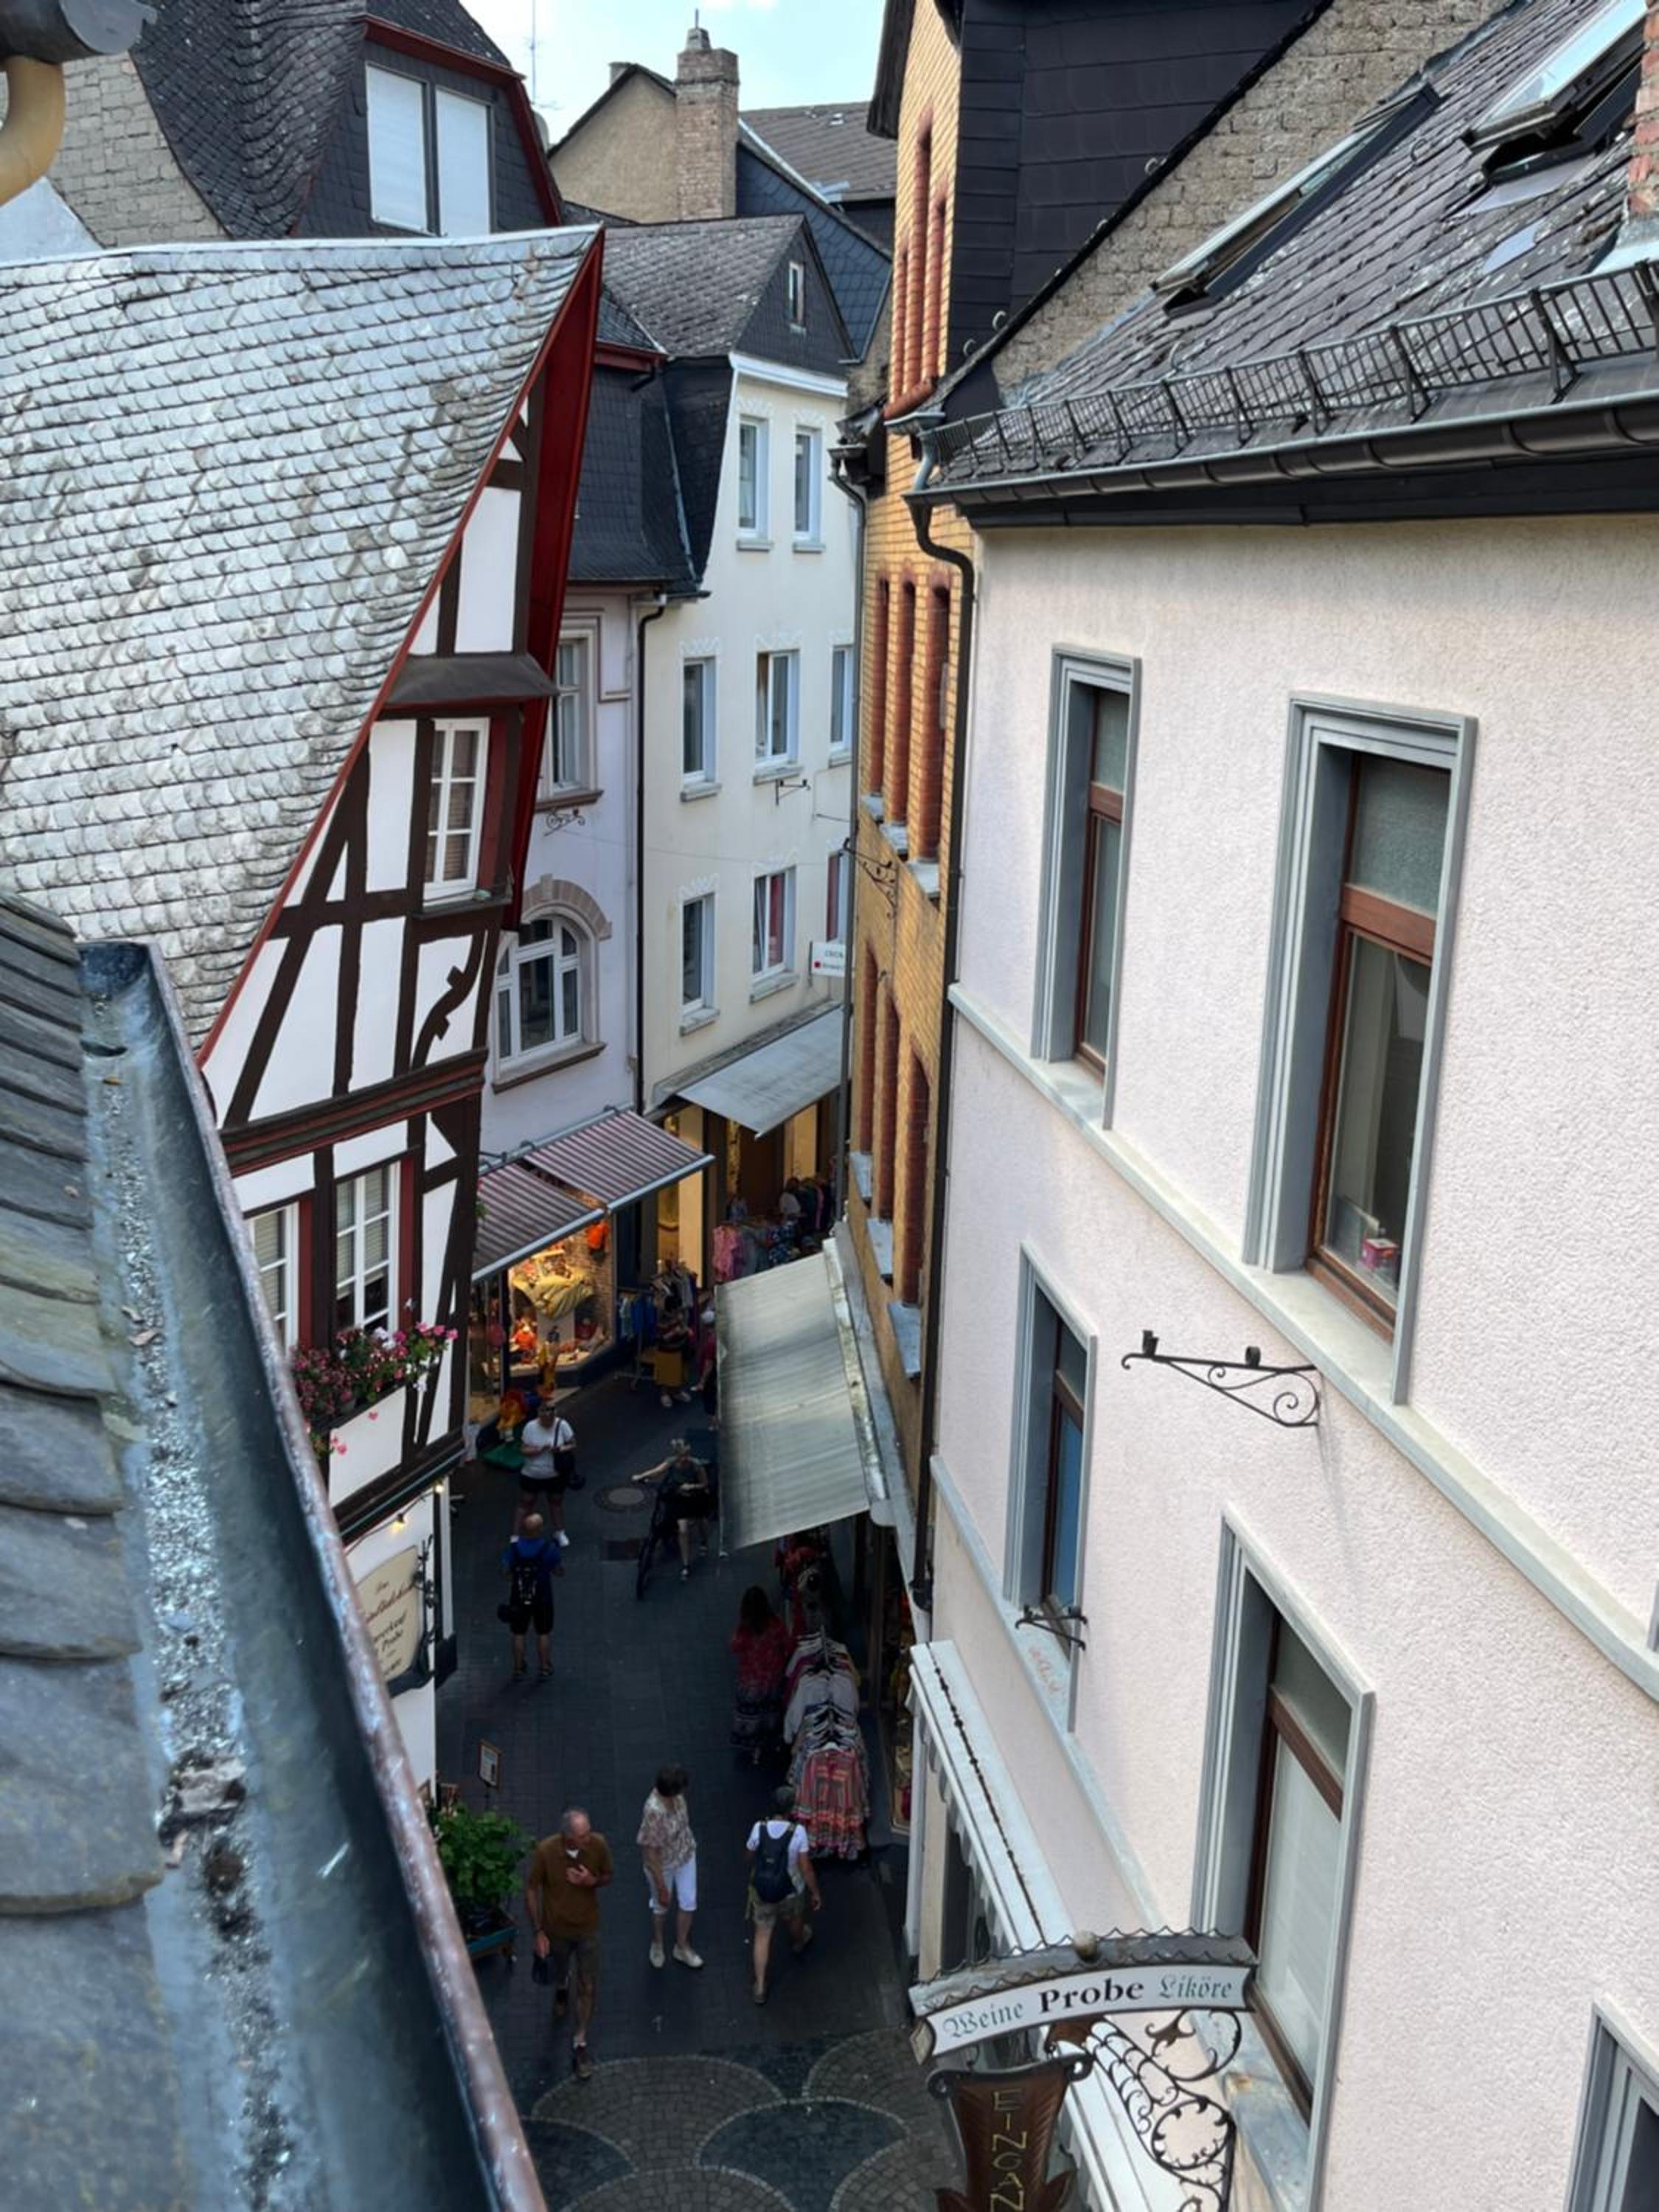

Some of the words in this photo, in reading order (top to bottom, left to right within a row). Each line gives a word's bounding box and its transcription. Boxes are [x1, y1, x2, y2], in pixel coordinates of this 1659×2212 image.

[942, 2003, 1024, 2038] Weine
[1039, 1977, 1144, 2014] Probe
[1158, 1973, 1233, 2000] Liköre
